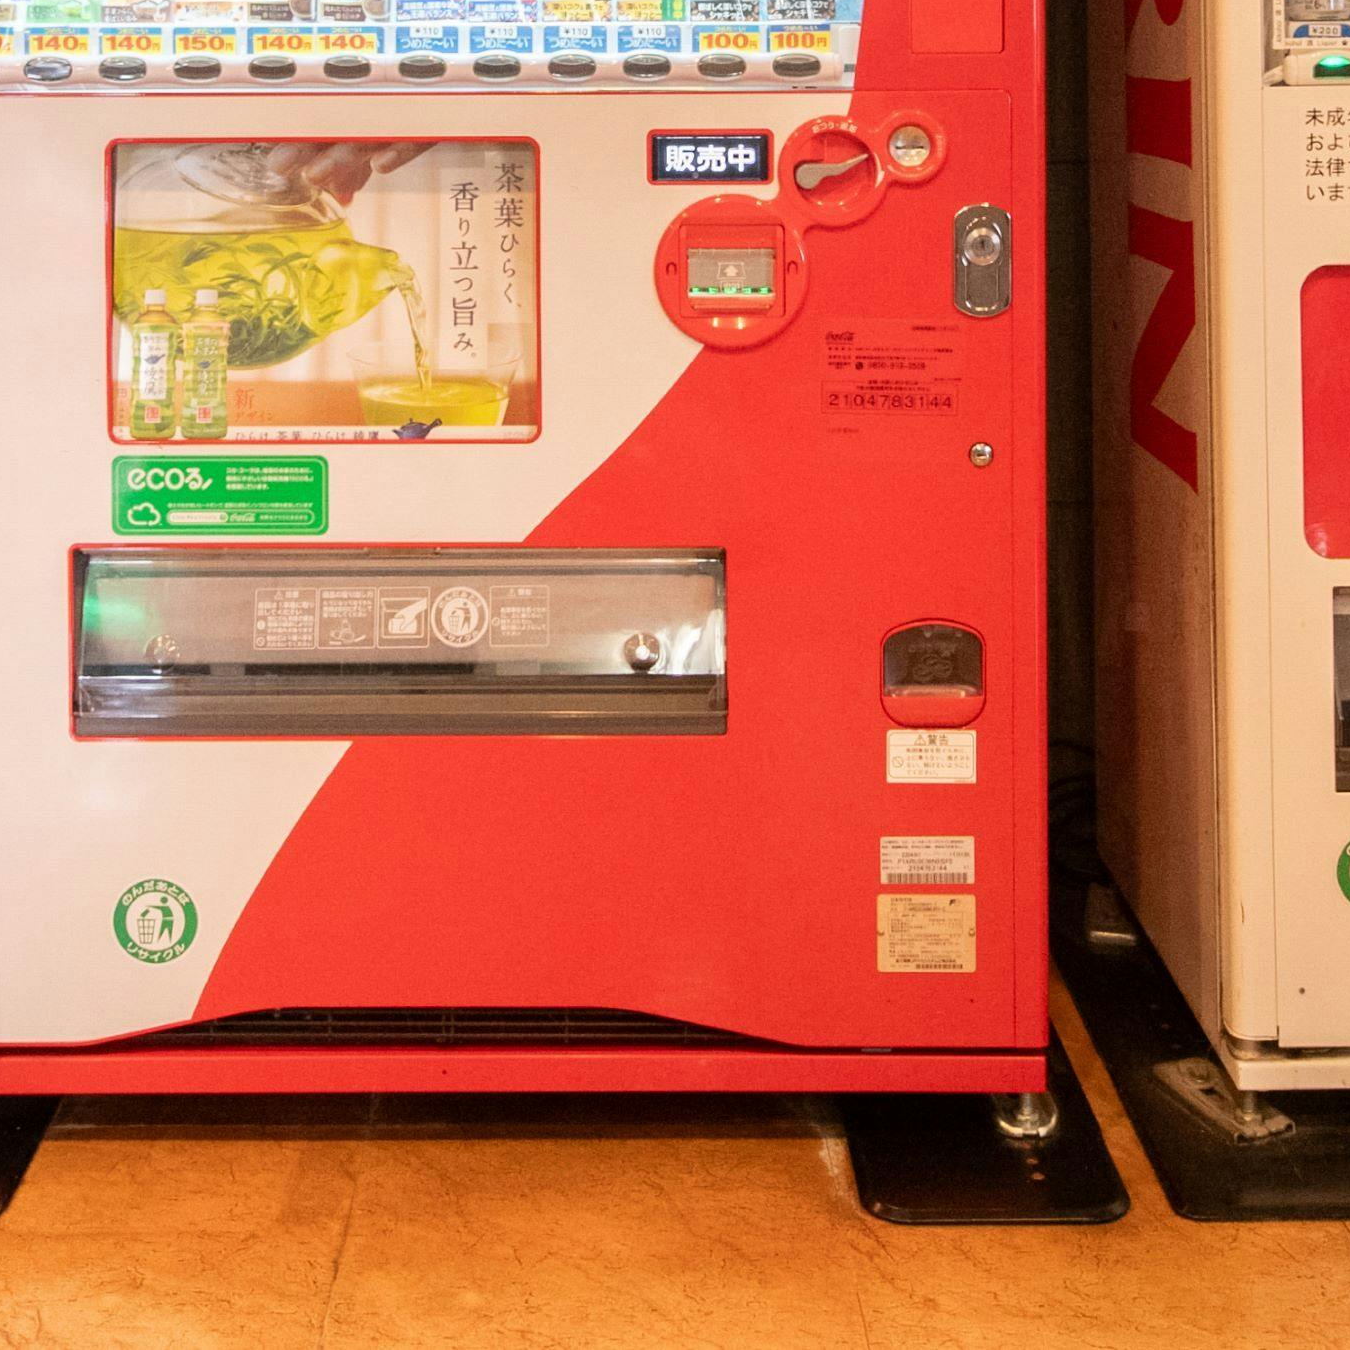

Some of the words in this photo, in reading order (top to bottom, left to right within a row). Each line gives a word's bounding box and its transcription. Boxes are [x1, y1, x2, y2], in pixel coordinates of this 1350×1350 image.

[774, 32, 827, 49] 100円
[665, 144, 756, 173] 販売中
[493, 161, 525, 309] 茶葉ひらく、
[449, 181, 481, 359] 香り立つ旨み。
[828, 393, 953, 409] 2104783144
